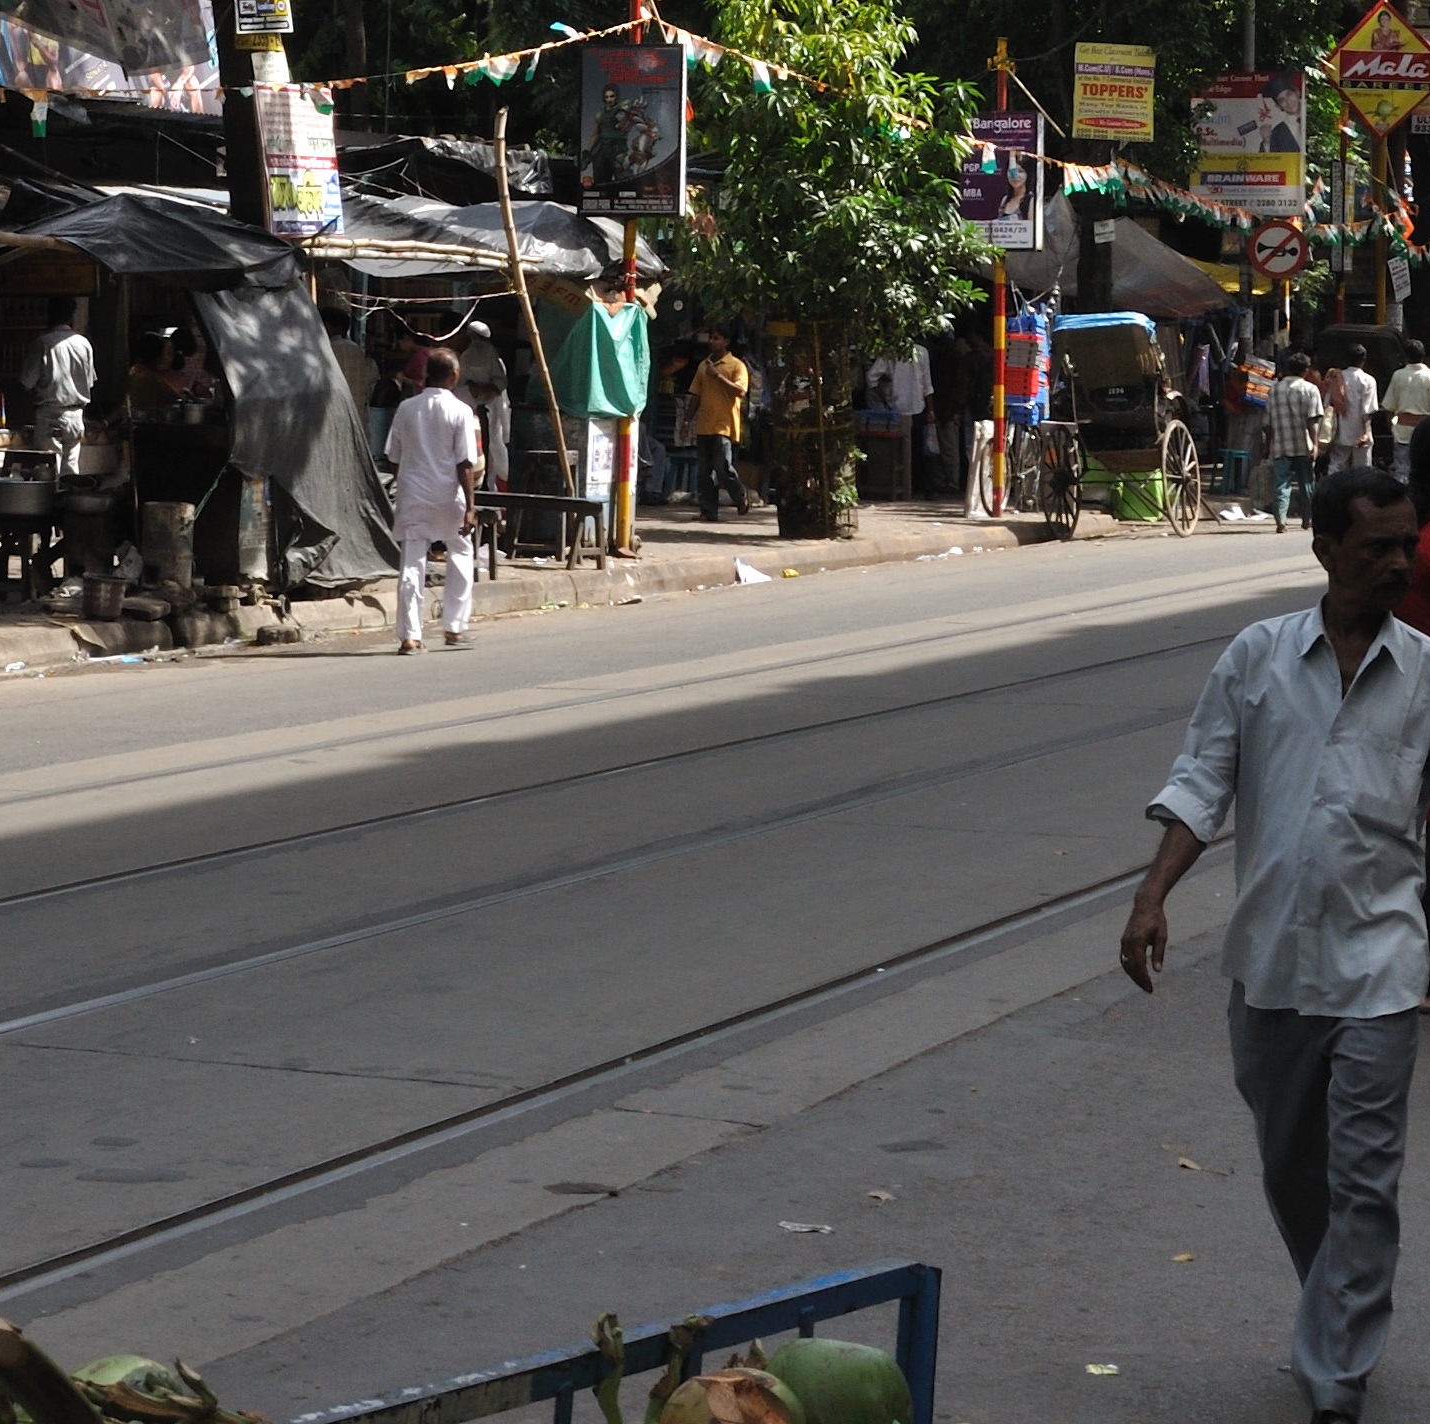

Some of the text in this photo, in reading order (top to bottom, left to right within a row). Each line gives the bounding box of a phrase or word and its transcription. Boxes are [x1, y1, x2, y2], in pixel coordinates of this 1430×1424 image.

[1343, 54, 1430, 79] Mala
[1081, 83, 1148, 99] TOPPERS'
[1342, 81, 1430, 90] SAREES
[972, 117, 1032, 134] Bangalore
[1201, 137, 1247, 148] ultimedia)
[963, 162, 980, 173] PGP
[1207, 174, 1280, 183] BRAINWARE
[962, 188, 983, 198] MBA
[1221, 199, 1298, 207] STREET 2280 3132
